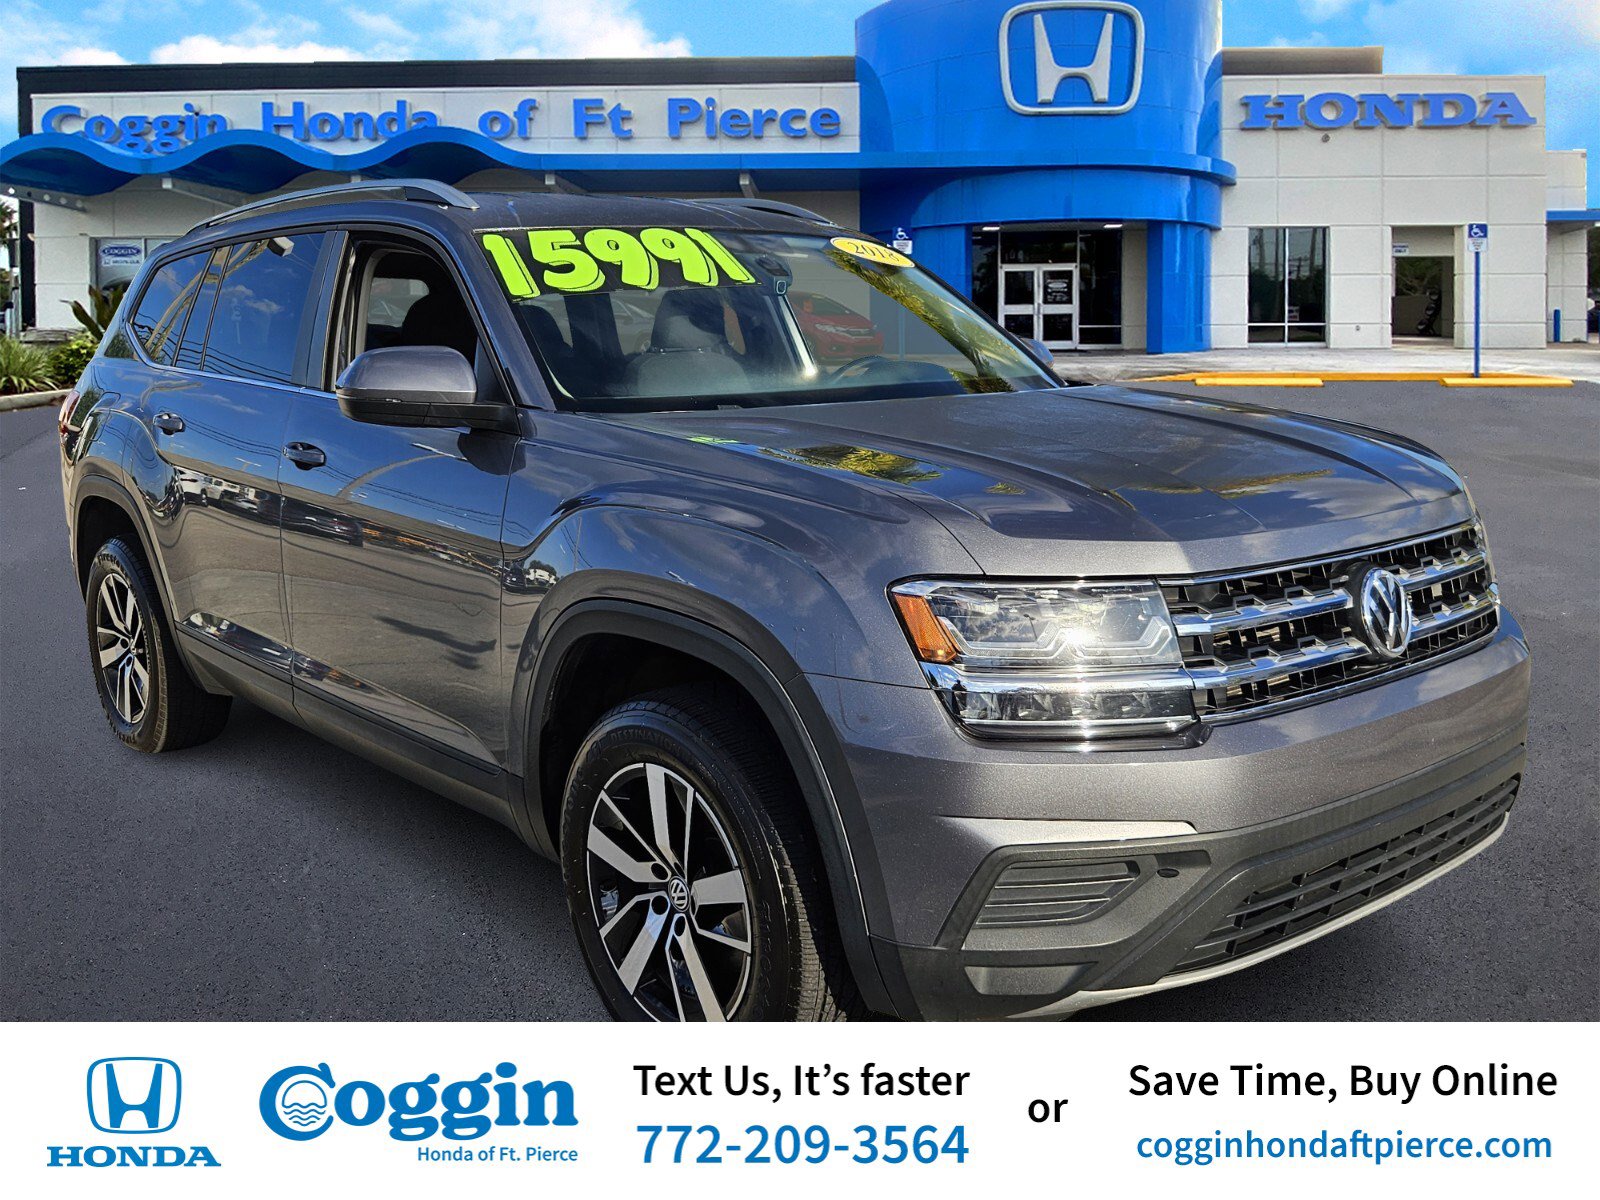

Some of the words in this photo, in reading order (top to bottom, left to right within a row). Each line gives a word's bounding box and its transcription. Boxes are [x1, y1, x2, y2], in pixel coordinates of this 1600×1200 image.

[41, 102, 227, 153] Coggin
[261, 100, 438, 140] Honda
[478, 99, 538, 139] of
[573, 98, 633, 139] Ft
[667, 97, 842, 138] Pierce
[1241, 92, 1537, 129] HONDA
[482, 227, 757, 298] 15991
